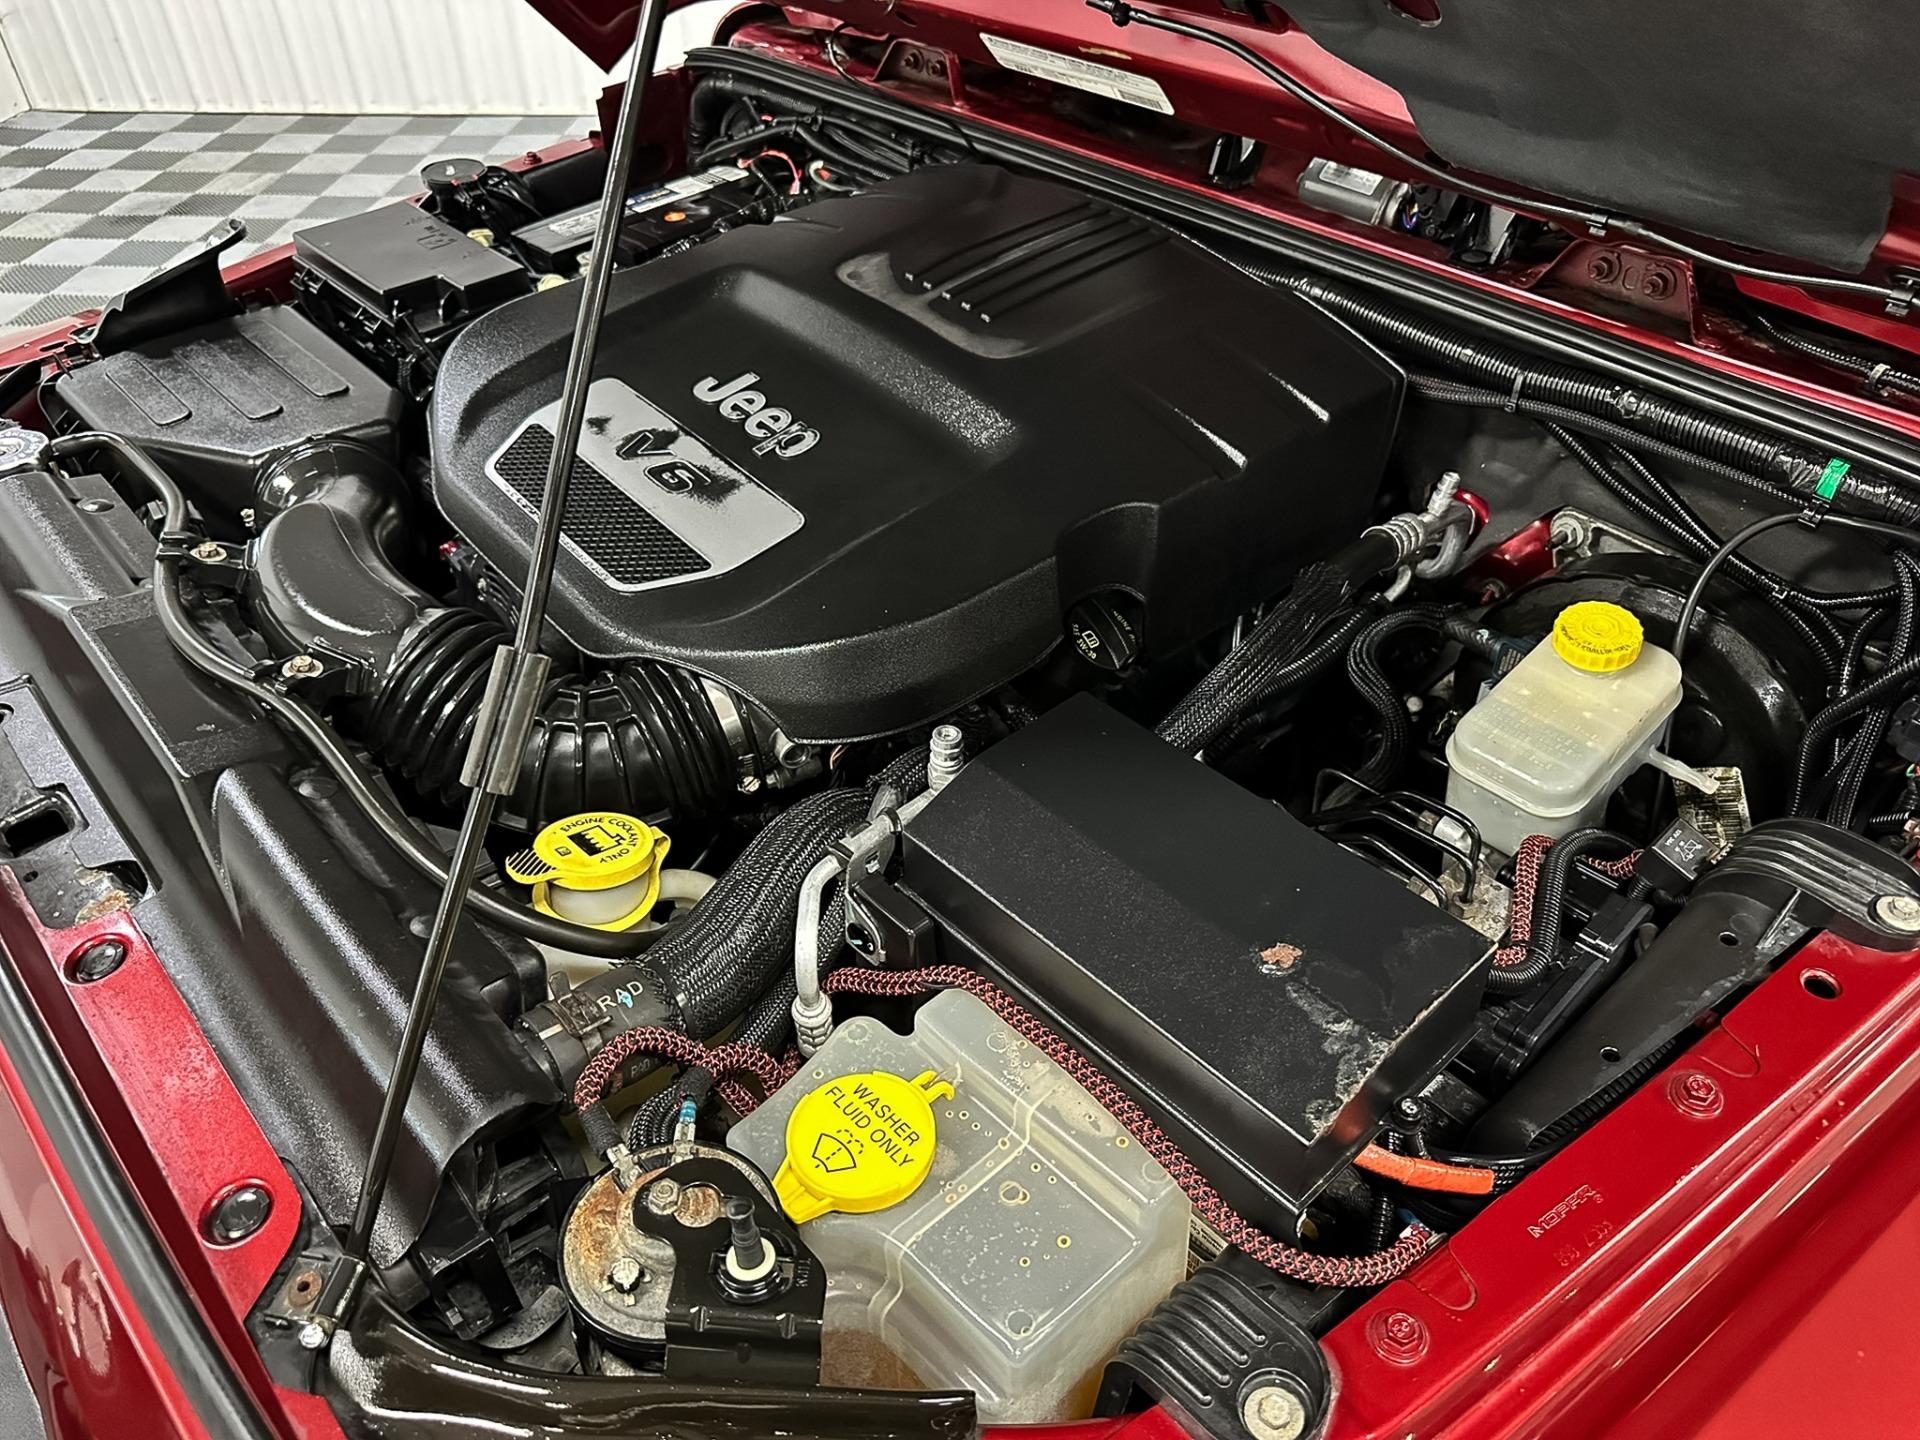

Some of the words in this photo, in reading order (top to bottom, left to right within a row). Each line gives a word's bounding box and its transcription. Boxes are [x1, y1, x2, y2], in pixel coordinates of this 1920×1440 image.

[692, 371, 821, 459] Jeep
[615, 430, 712, 495] V6
[559, 816, 606, 833] ENGINE
[599, 847, 631, 864] ONLY
[824, 1085, 872, 1129] FLUID
[869, 1128, 915, 1168] ONLY
[852, 1082, 921, 1147] WASHER
